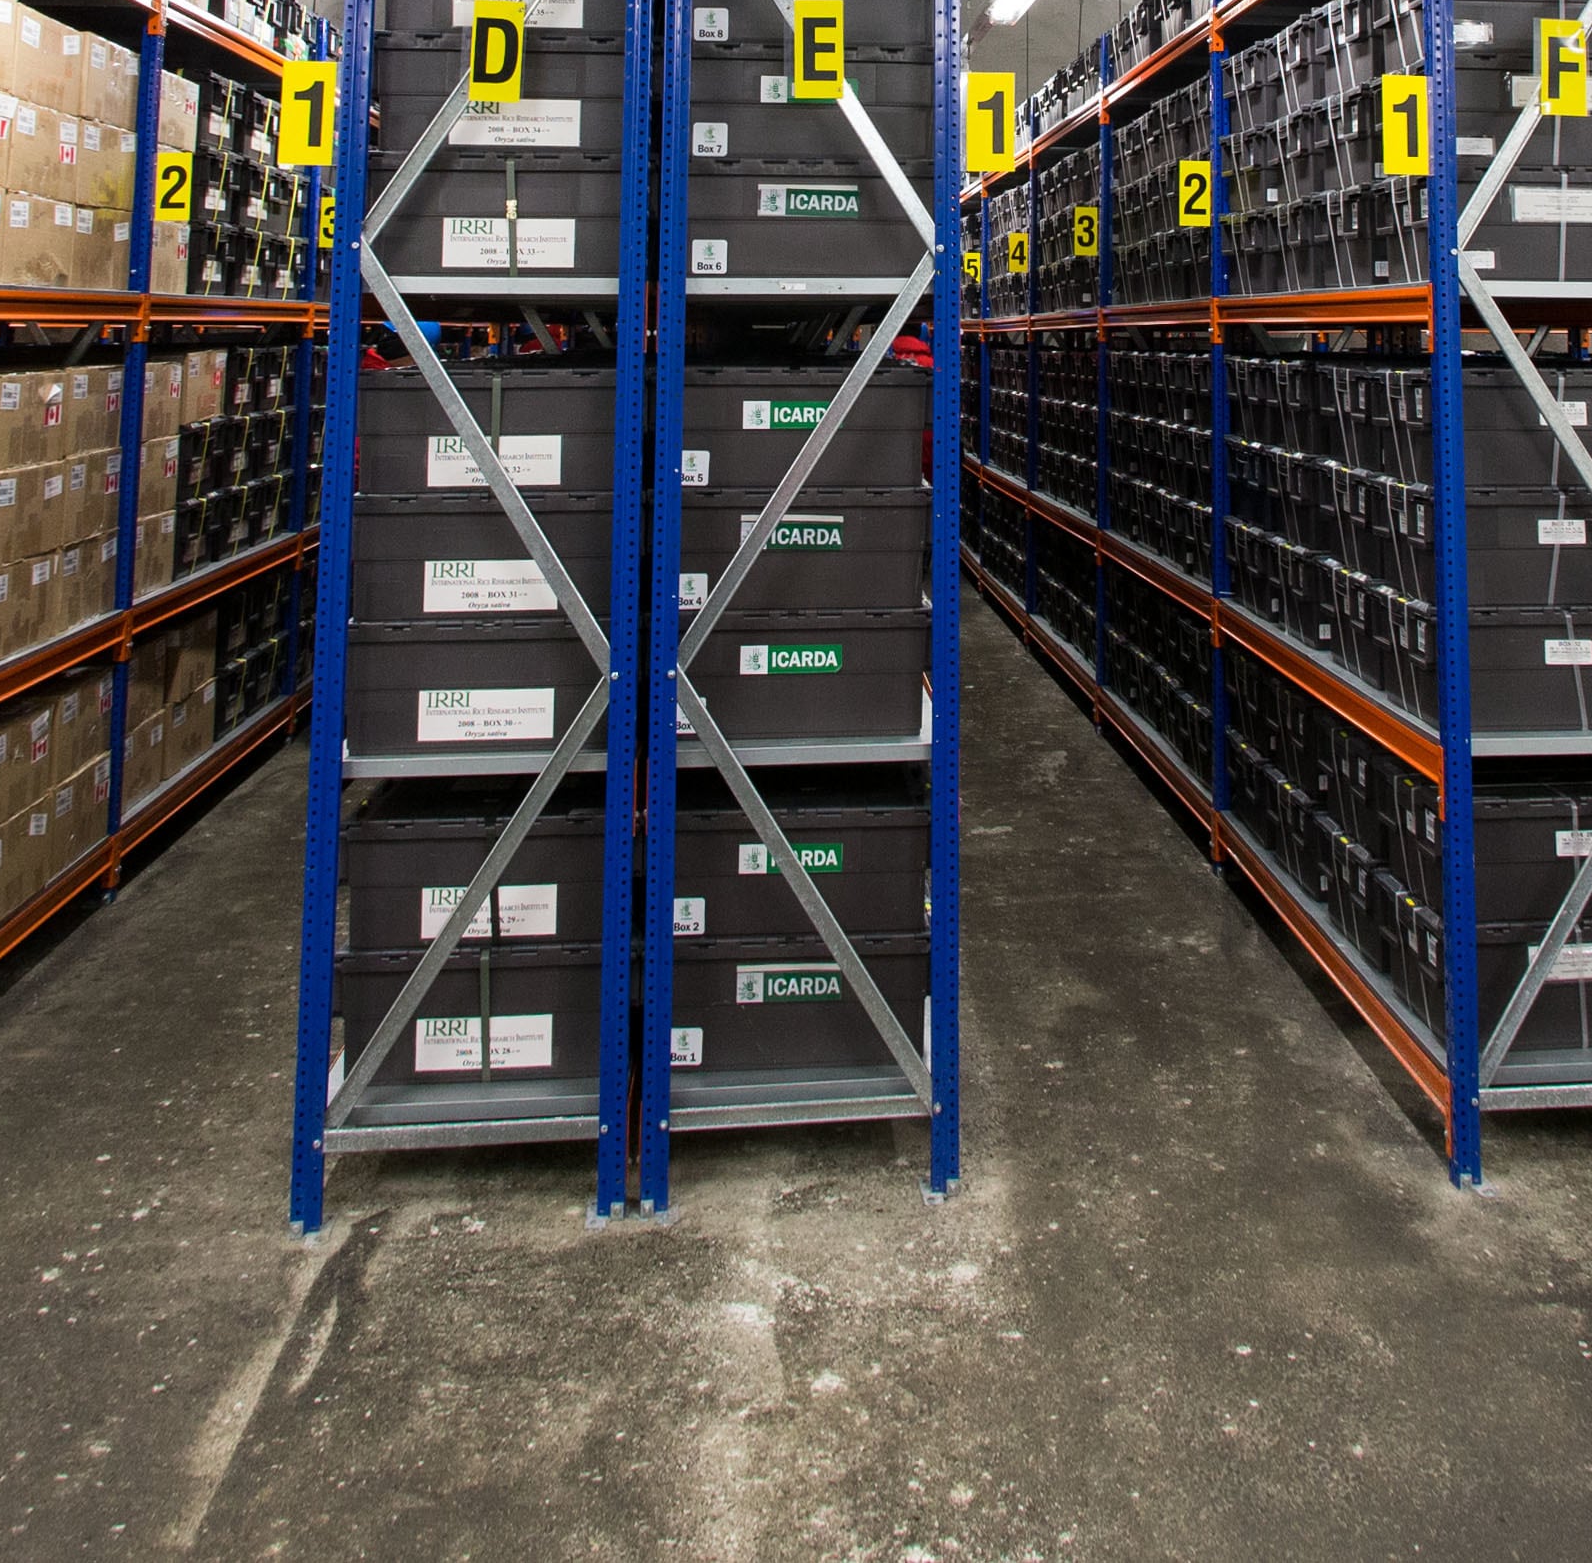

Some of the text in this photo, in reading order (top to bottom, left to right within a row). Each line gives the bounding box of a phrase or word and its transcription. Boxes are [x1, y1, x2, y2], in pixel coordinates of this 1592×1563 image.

[699, 29, 723, 37] Box 8
[473, 18, 518, 83] D
[803, 18, 837, 80] E
[1549, 37, 1579, 98] F
[294, 81, 323, 146] 1
[978, 92, 1003, 153] 1
[1394, 95, 1417, 157] 1
[698, 144, 722, 153] Box 7
[160, 166, 186, 208] 2
[1184, 174, 1206, 214] 2
[790, 194, 858, 212] ICARDA
[451, 220, 493, 234] IRRI
[1077, 216, 1094, 247] 3
[1012, 241, 1026, 265] 4
[697, 262, 722, 270] Box 6
[967, 259, 978, 280] 5
[774, 407, 828, 423] ICARD
[698, 474, 703, 482] 5
[771, 528, 842, 545] ICARDA
[433, 563, 475, 578] IRRI
[696, 597, 702, 605] 4
[772, 651, 838, 668] ICARDA
[427, 692, 470, 708] IRRI
[674, 922, 699, 931] Box 2
[768, 977, 840, 996] ICARDA
[425, 1020, 468, 1037] IRRI
[671, 1052, 696, 1061] Box 1
